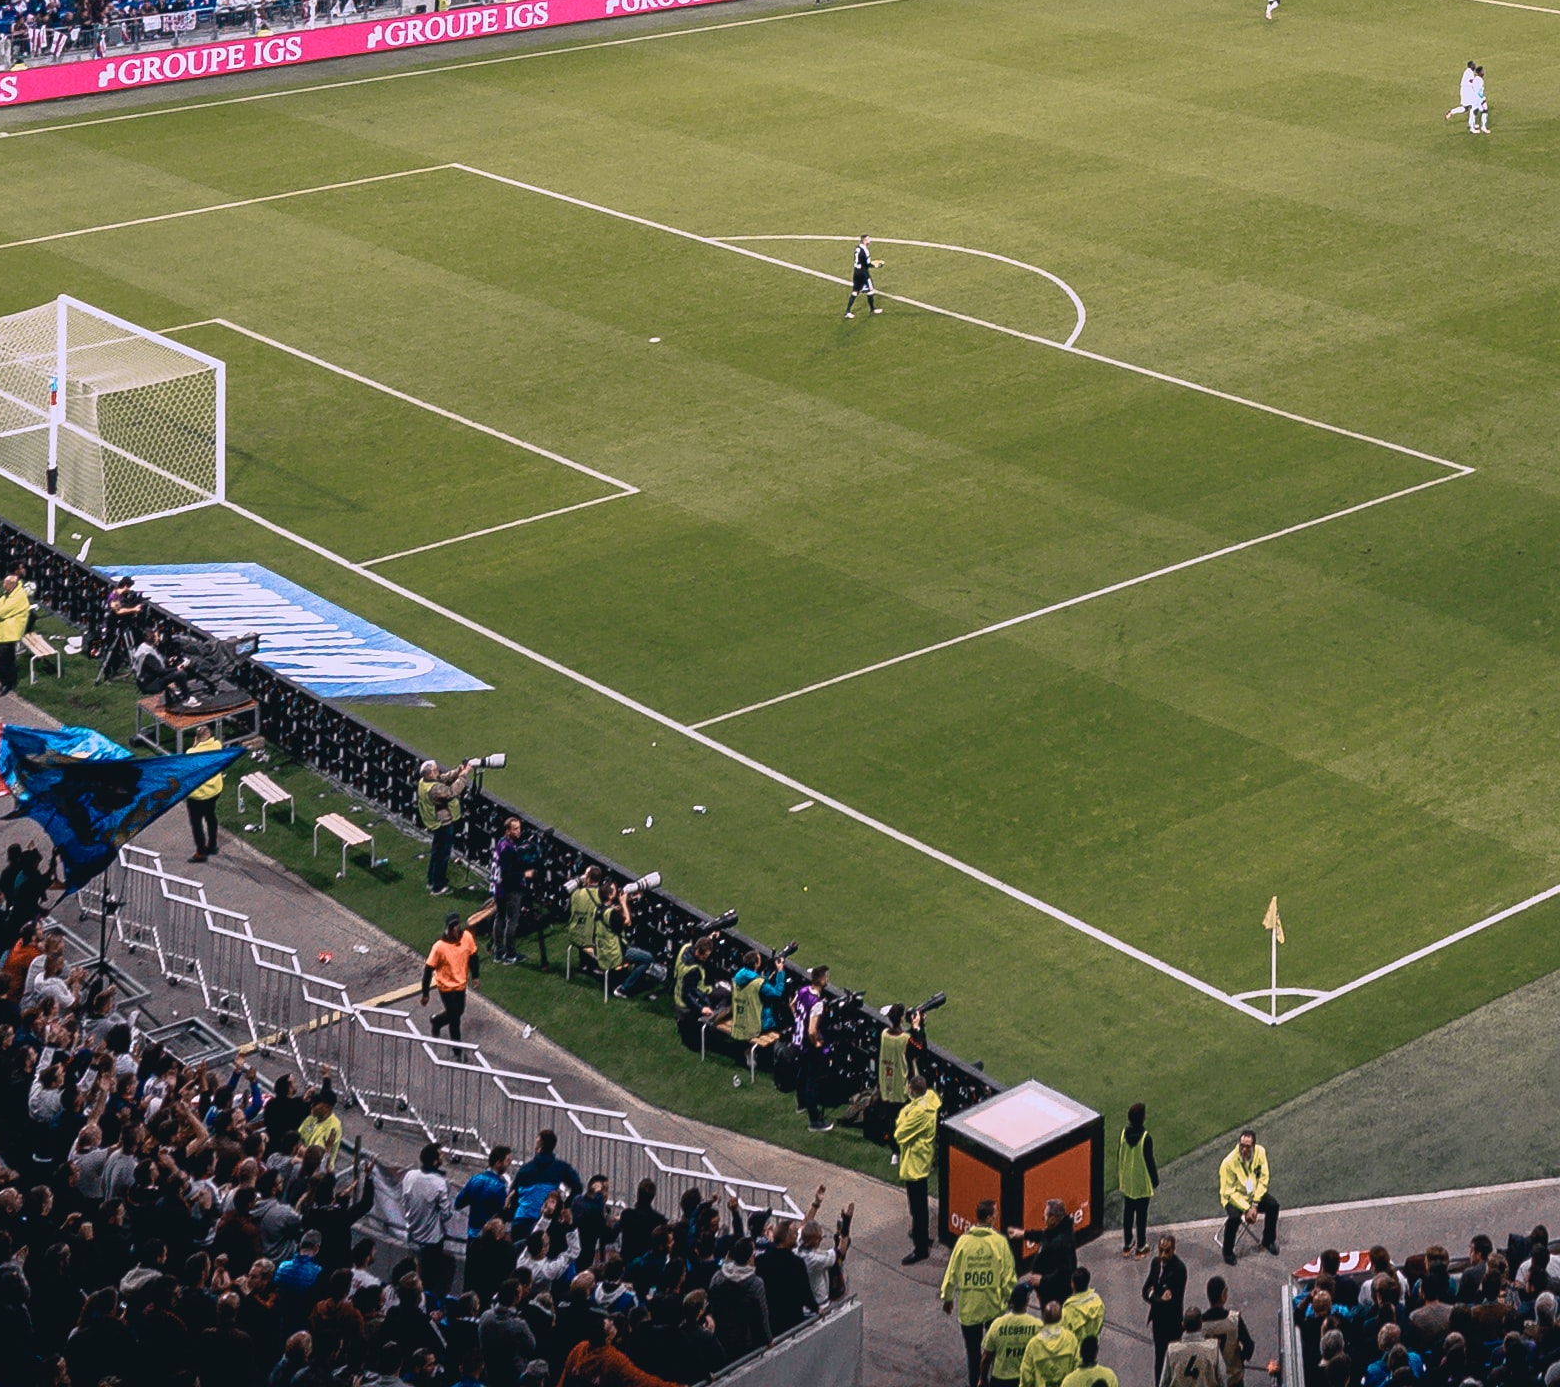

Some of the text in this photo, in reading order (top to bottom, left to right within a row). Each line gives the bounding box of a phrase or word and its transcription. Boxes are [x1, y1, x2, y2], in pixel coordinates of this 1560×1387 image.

[383, 1, 549, 48] GROUPE IGS
[117, 36, 302, 85] GROUPE IGS
